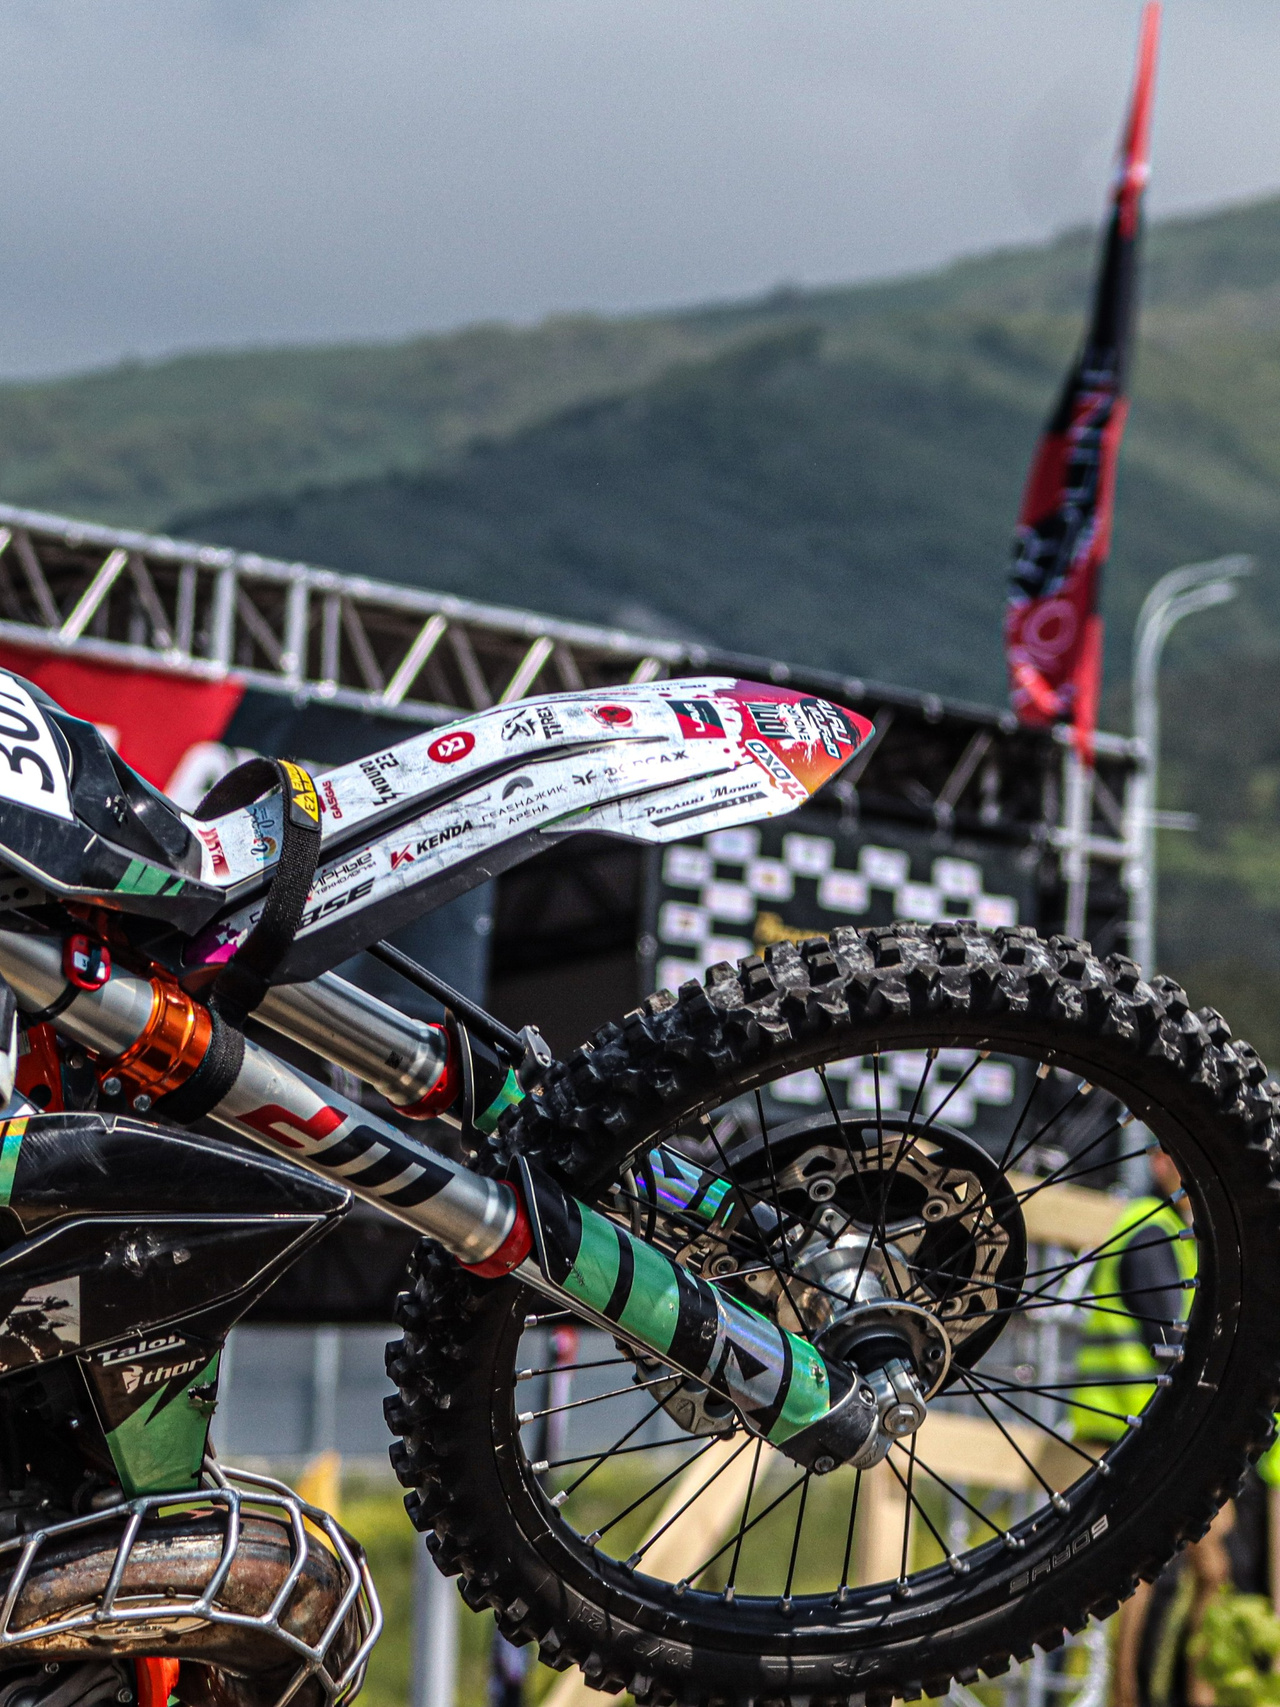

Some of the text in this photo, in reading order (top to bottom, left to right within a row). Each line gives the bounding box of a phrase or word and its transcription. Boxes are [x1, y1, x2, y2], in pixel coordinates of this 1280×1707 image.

[322, 780, 343, 820] GASGAS
[482, 784, 569, 822] ГЕЛЕНДЖИК
[508, 803, 550, 826] АРЕНА
[417, 819, 474, 855] KENDA
[143, 1356, 206, 1386] thor
